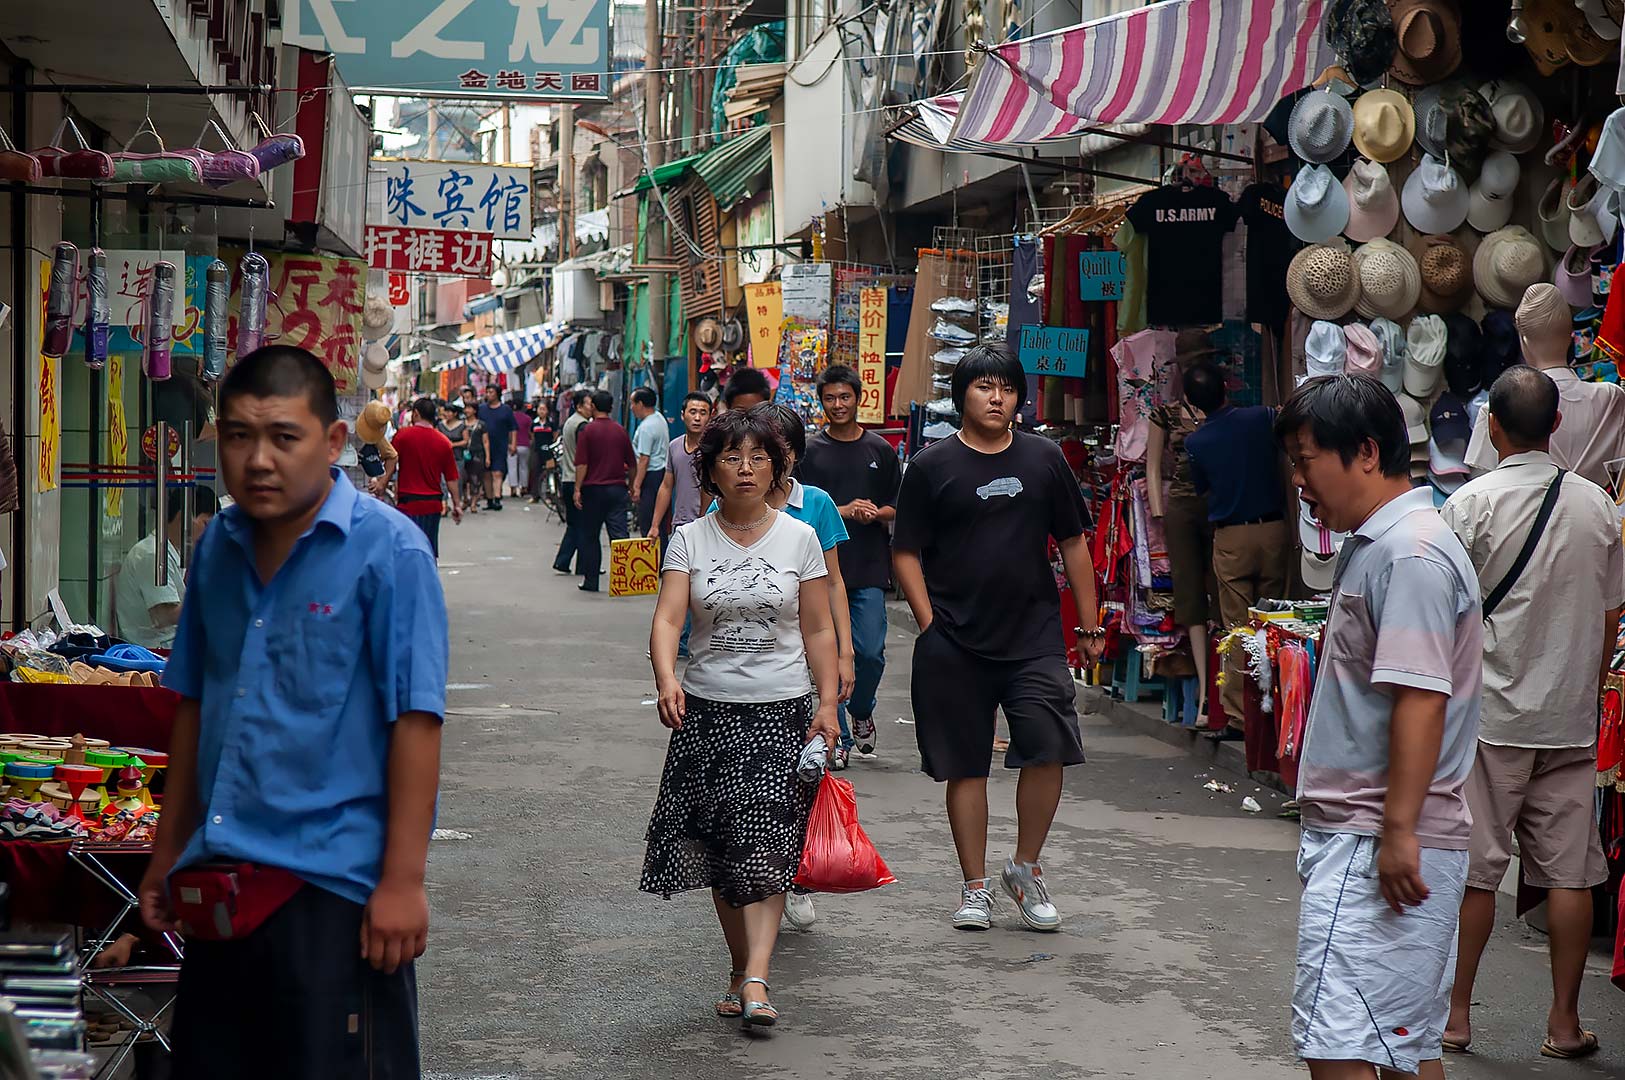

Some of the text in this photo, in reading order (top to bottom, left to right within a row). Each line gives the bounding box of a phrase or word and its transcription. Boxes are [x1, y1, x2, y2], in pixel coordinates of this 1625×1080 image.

[459, 69, 600, 92] 金地天园
[387, 166, 529, 233] 珠宾馆
[1155, 207, 1216, 223] U.S.ARMY
[364, 227, 489, 274] 扦裤边
[1081, 256, 1111, 279] Quilt
[1023, 330, 1087, 352] Table Cloth
